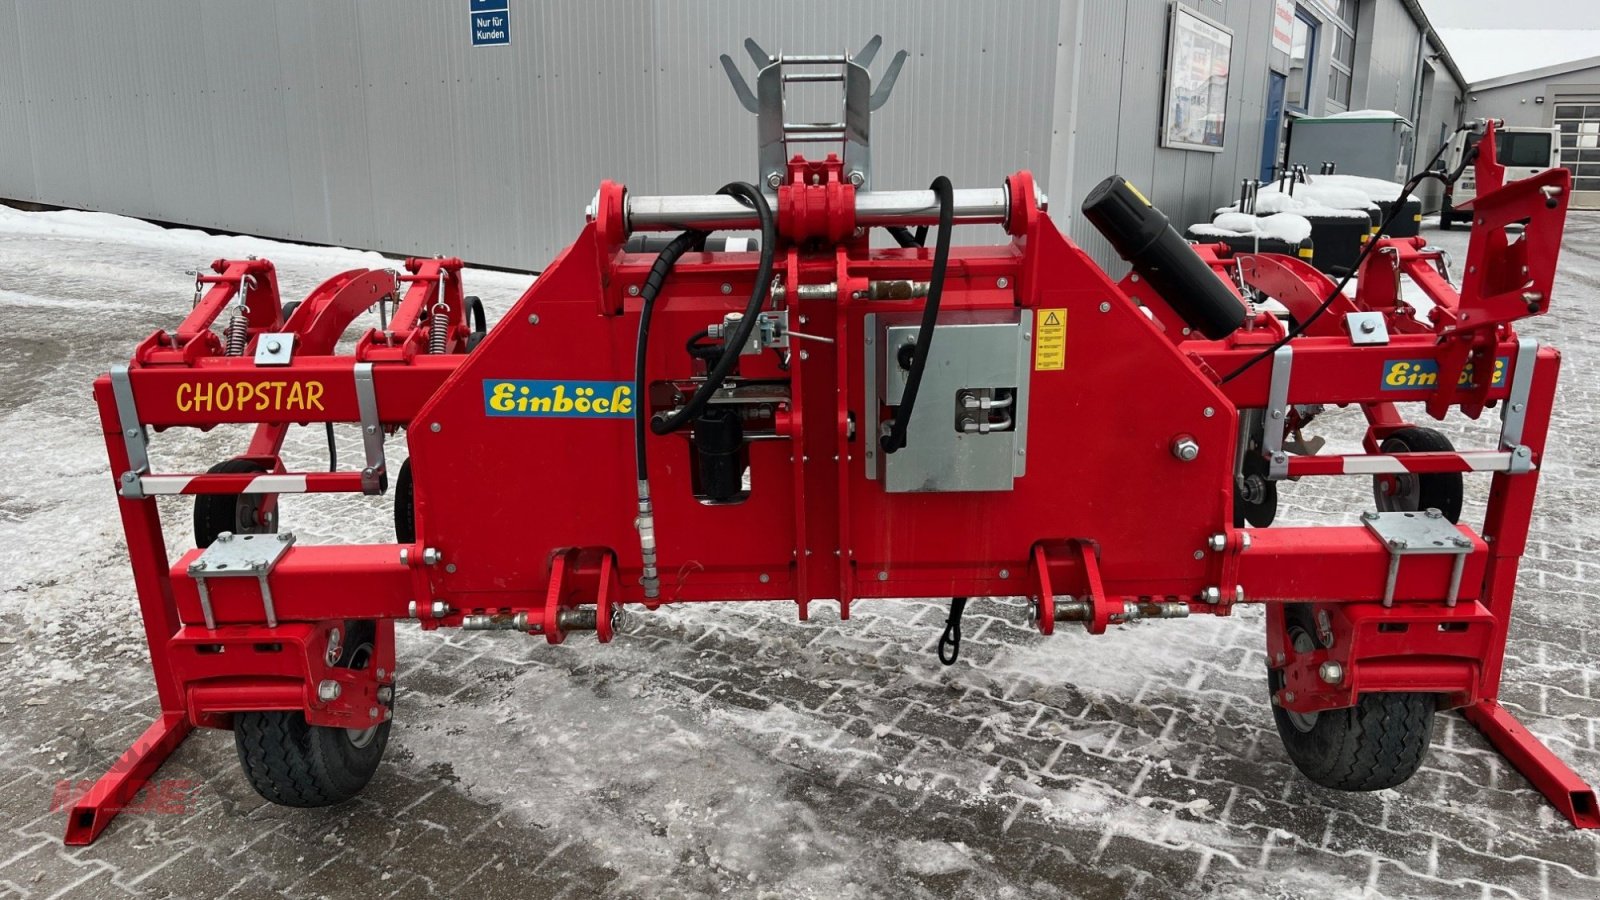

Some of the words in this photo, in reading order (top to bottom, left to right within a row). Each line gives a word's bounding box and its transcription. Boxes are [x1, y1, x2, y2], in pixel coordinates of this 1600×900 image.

[476, 18, 491, 28] Nur
[492, 17, 503, 26] für
[476, 30, 505, 40] Kunden
[176, 381, 325, 412] CHOPSTAR
[489, 382, 632, 413] Einböck
